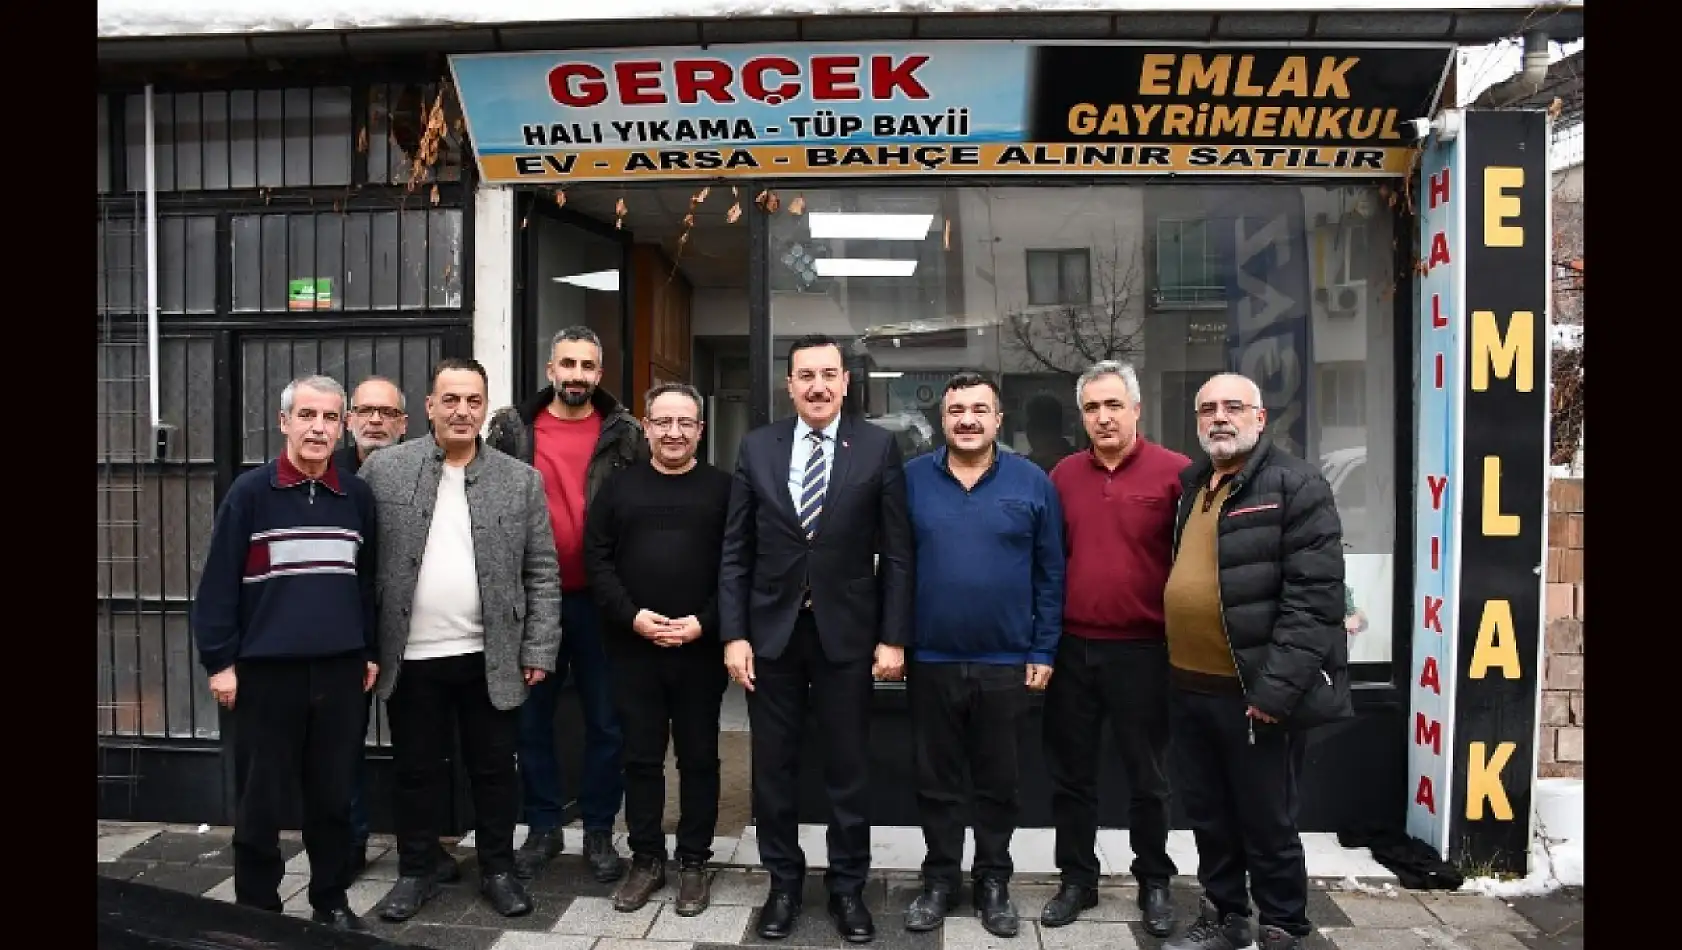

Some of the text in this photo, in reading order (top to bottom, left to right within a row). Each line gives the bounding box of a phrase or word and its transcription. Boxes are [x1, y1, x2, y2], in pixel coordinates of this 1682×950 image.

[548, 56, 931, 108] GERÇEK
[1138, 53, 1361, 99] EMLAK
[523, 123, 603, 146] HALI
[612, 118, 757, 142] YIKAMA
[790, 110, 863, 137] TÜP
[515, 154, 578, 175] EV
[624, 149, 759, 171] ARSA
[808, 146, 980, 170] BAHÇE
[998, 145, 1172, 166] ALINIR
[1189, 146, 1386, 169] SATILIR
[1414, 168, 1450, 815] HALI YIKAMA
[1465, 165, 1534, 821] EMLAK
